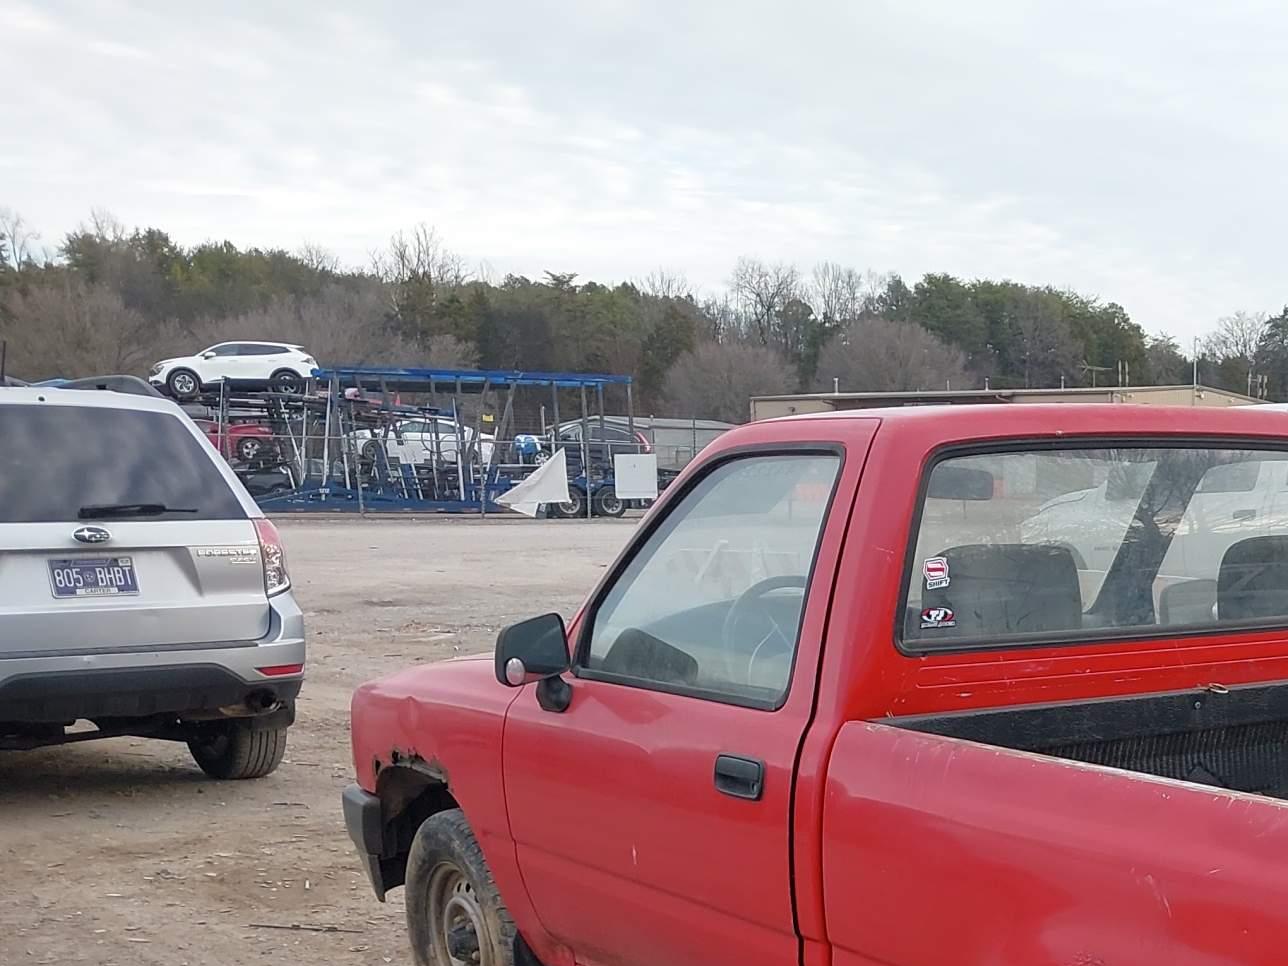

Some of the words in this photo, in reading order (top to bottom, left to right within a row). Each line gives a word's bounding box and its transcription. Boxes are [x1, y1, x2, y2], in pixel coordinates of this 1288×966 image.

[54, 568, 84, 588] 805
[95, 566, 133, 587] BHBT
[928, 579, 949, 588] SHIFT
